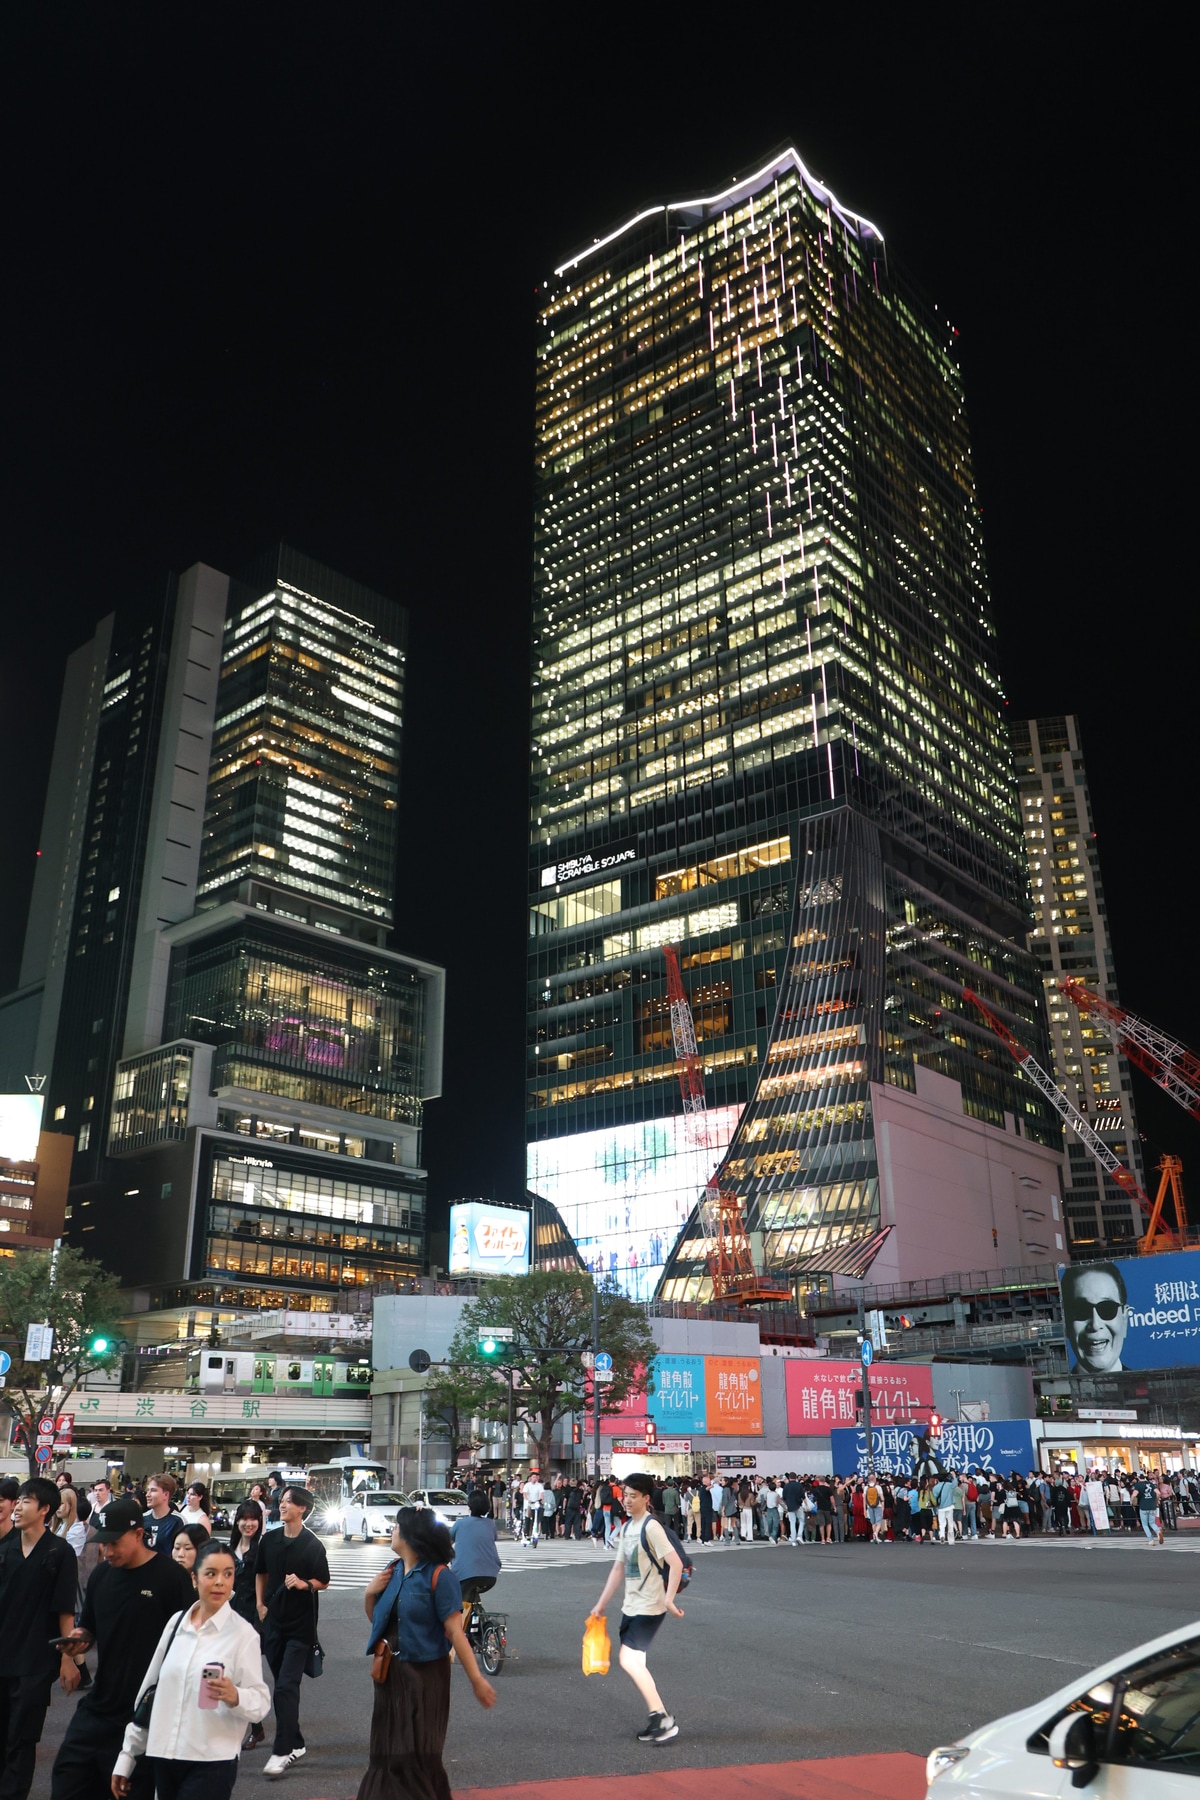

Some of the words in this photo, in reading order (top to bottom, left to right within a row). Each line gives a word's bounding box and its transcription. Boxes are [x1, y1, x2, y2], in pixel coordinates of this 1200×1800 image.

[557, 861, 600, 882] SCRAMBLE
[600, 849, 635, 868] SQUARE
[558, 854, 592, 873] SHIBUYA
[481, 1225, 518, 1238] ファイト
[1154, 1280, 1199, 1304] 採用は
[1128, 1303, 1190, 1327] indeed
[661, 1370, 693, 1389] 龍角散
[718, 1372, 749, 1390] 龍角散
[80, 1398, 100, 1410] JR
[135, 1397, 261, 1419] 渋谷駅
[856, 1427, 914, 1456] この国の
[938, 1424, 995, 1454] 採用の
